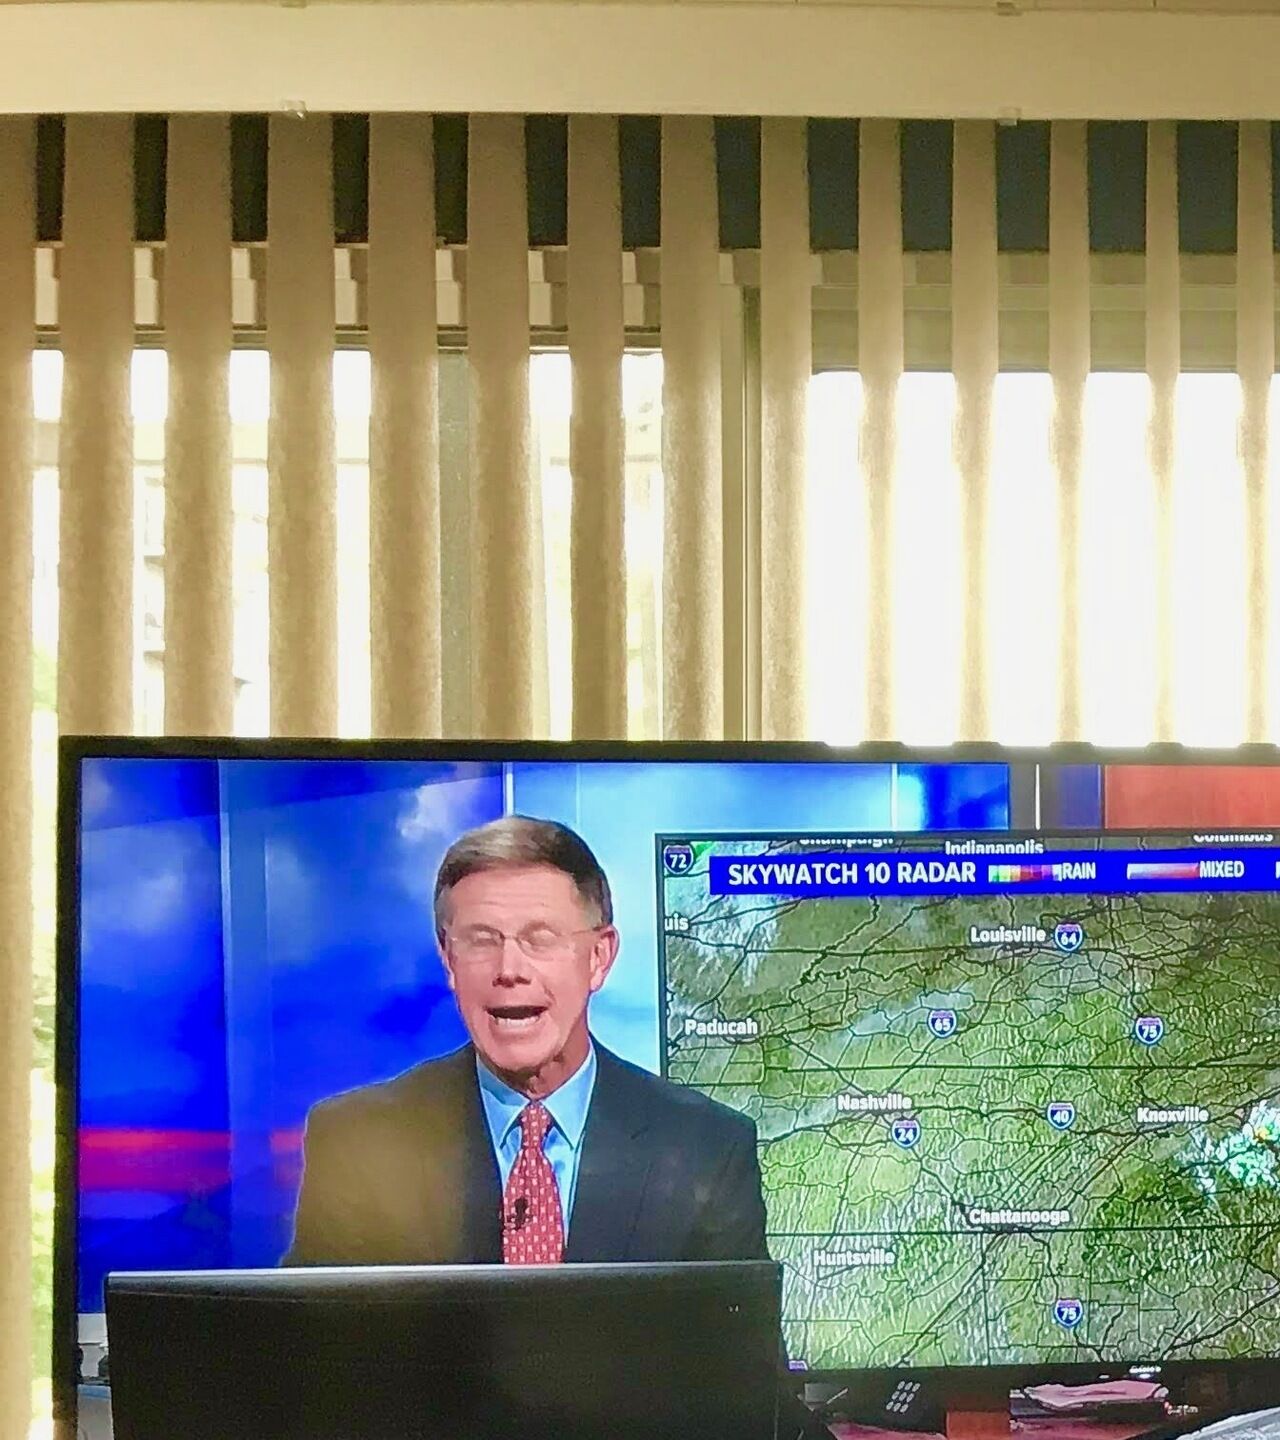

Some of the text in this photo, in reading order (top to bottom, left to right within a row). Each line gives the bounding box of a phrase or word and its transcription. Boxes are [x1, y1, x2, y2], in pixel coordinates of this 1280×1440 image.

[669, 853, 688, 869] 72
[728, 863, 858, 885] SKYWATCH
[864, 863, 891, 884] 10
[897, 861, 976, 883] RADAR
[1062, 862, 1096, 879] RAIN
[1200, 860, 1245, 878] MIXED
[970, 925, 1047, 943] Louisville
[1061, 932, 1078, 945] 64
[684, 1018, 758, 1036] Paducah
[934, 1019, 951, 1031] 65
[1142, 1025, 1157, 1037] 75
[837, 1093, 913, 1111] Nashville
[1053, 1110, 1069, 1123] 40
[1136, 1106, 1210, 1123] Knoxville
[897, 1129, 914, 1141] 24
[968, 1207, 1070, 1226] Chattanooga
[812, 1248, 896, 1266] Huntsville
[1060, 1307, 1076, 1320] 75
